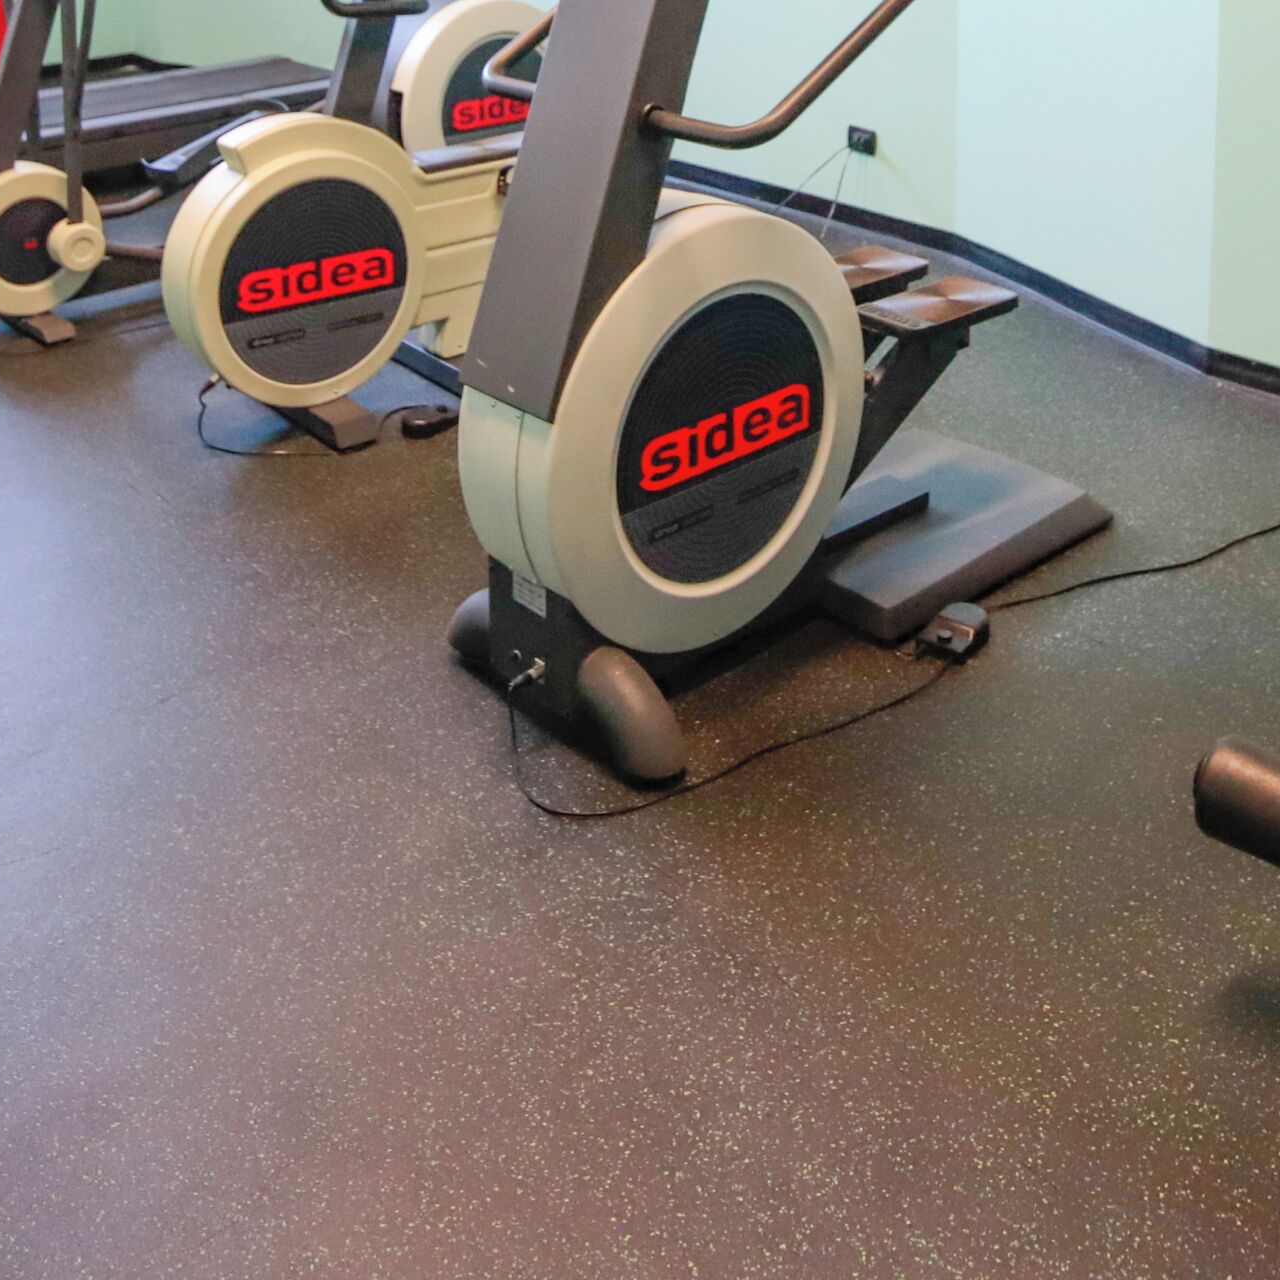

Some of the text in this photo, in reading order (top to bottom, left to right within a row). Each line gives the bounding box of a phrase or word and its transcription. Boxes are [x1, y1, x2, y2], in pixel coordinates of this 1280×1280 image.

[458, 95, 524, 125] side
[247, 255, 388, 305] sidea
[649, 392, 805, 482] sidea
